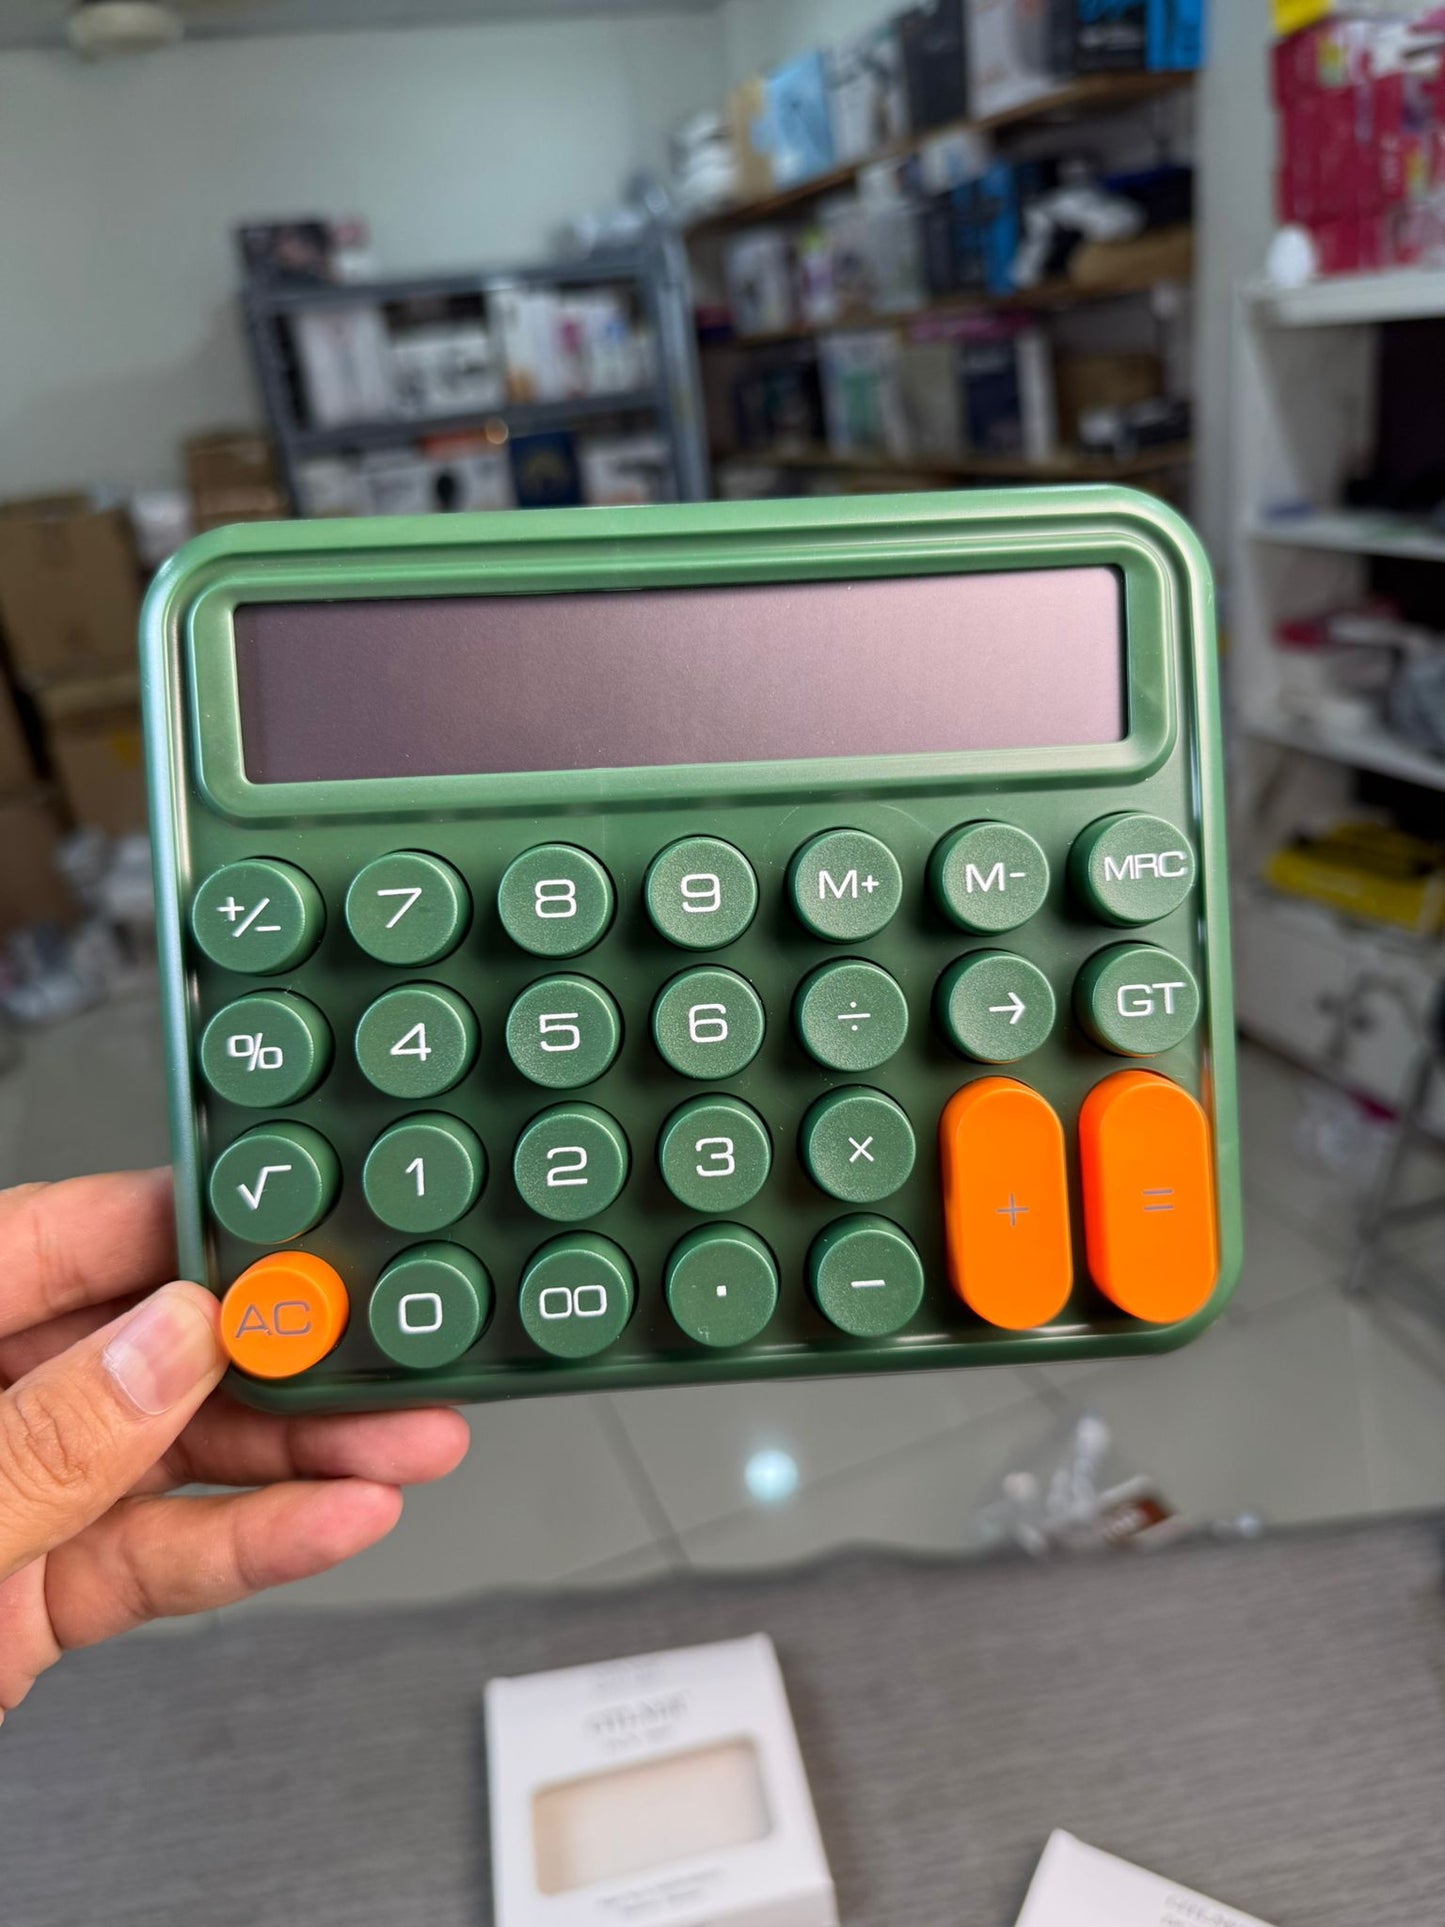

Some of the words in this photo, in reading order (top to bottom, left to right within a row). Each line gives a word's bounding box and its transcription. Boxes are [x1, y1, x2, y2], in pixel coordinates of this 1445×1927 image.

[818, 869, 880, 899] M+
[964, 863, 1026, 893] M-
[1104, 851, 1187, 881] MRC
[377, 887, 422, 928] 7
[534, 879, 577, 918] 8
[680, 873, 721, 912] 9
[1116, 981, 1186, 1017] GT
[390, 1023, 432, 1061] 4
[539, 1013, 580, 1052] 5
[688, 1003, 728, 1043] 6
[227, 1033, 283, 1071] %
[405, 1157, 425, 1196] 1
[546, 1146, 588, 1187] 2
[695, 1137, 735, 1177] 3
[235, 1301, 312, 1338] AC
[399, 1293, 443, 1334] 0
[539, 1285, 607, 1320] 00
